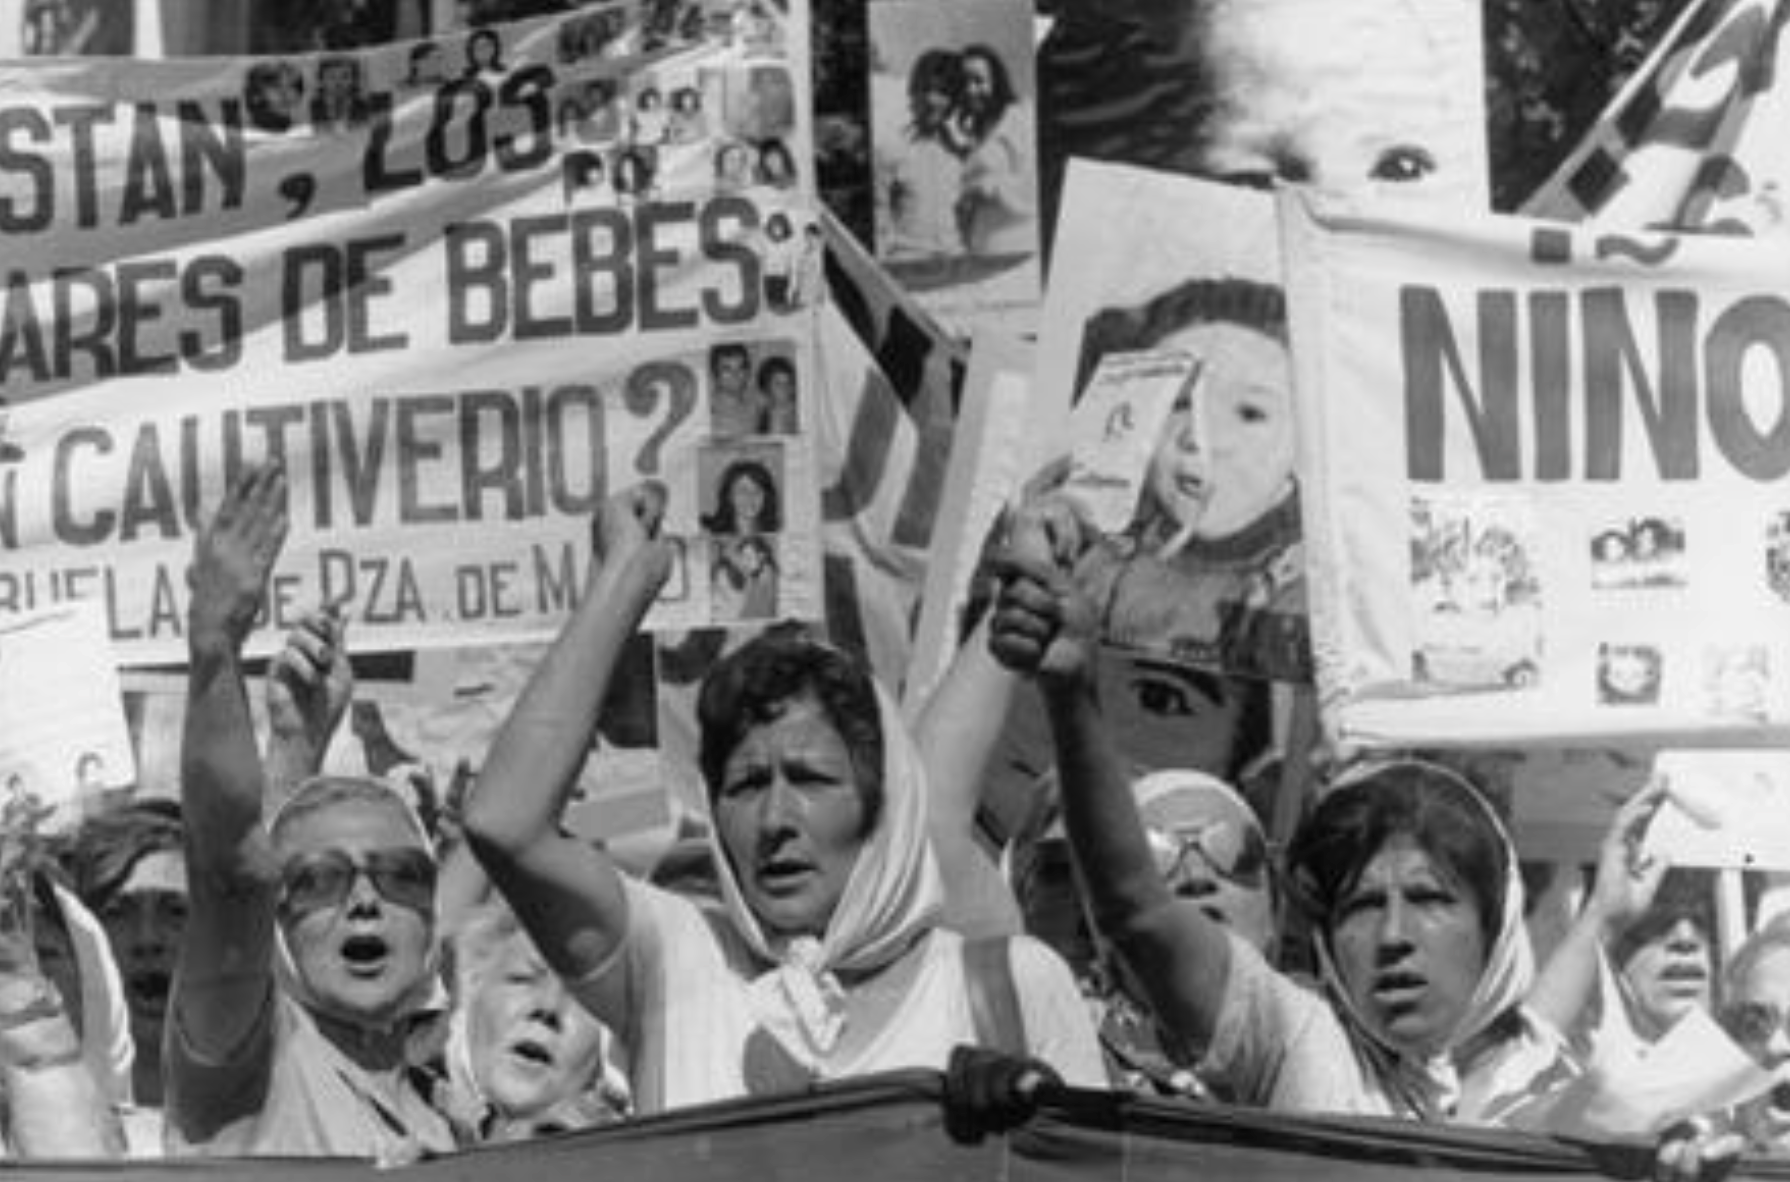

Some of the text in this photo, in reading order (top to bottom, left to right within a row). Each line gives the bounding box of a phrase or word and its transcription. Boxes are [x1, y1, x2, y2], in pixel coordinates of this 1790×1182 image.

[364, 64, 555, 192] LOS
[282, 232, 409, 363] DE
[444, 197, 761, 345] BEBES
[455, 562, 521, 621] DE
